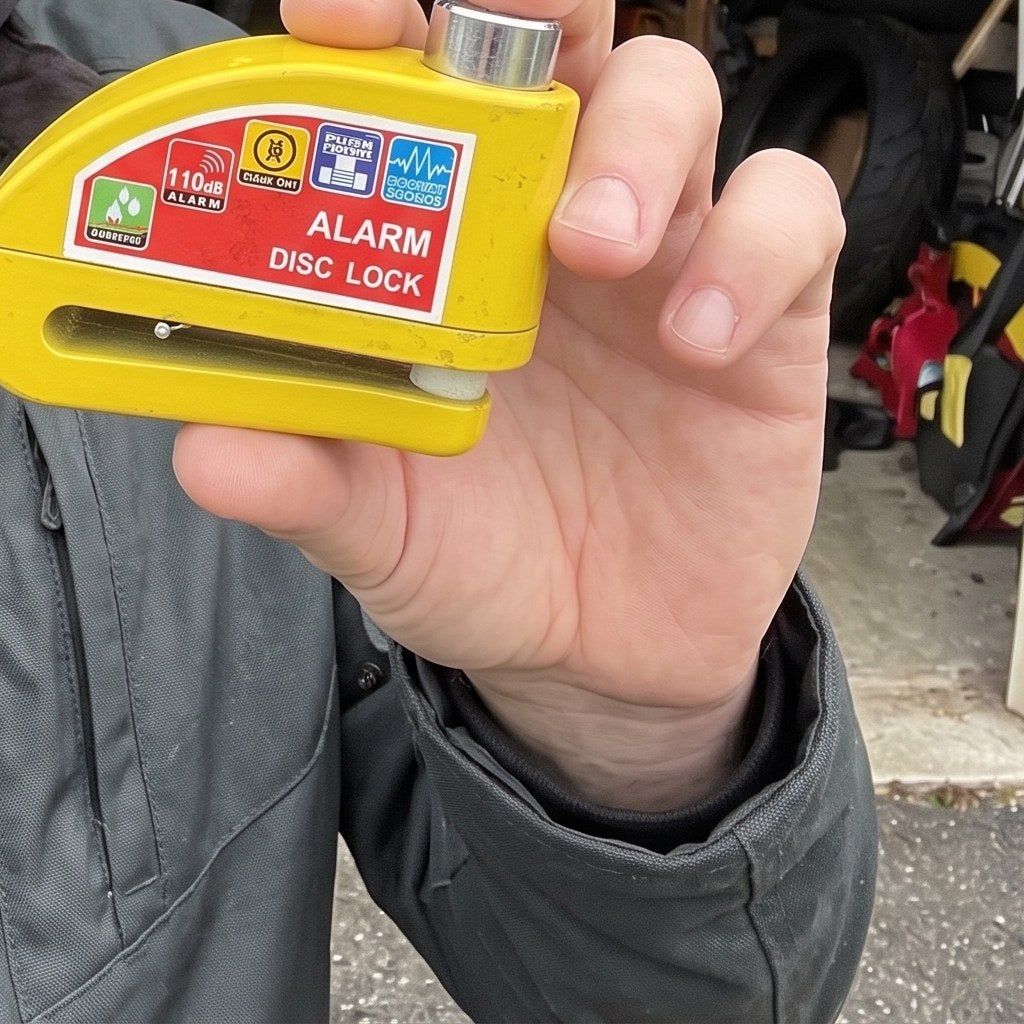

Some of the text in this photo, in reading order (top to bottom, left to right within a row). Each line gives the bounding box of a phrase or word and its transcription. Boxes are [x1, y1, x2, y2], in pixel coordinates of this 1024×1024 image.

[169, 167, 224, 195] 110dB
[167, 191, 221, 210] ALARM
[306, 210, 432, 258] ALARM
[269, 246, 424, 297] DISC LOCK
